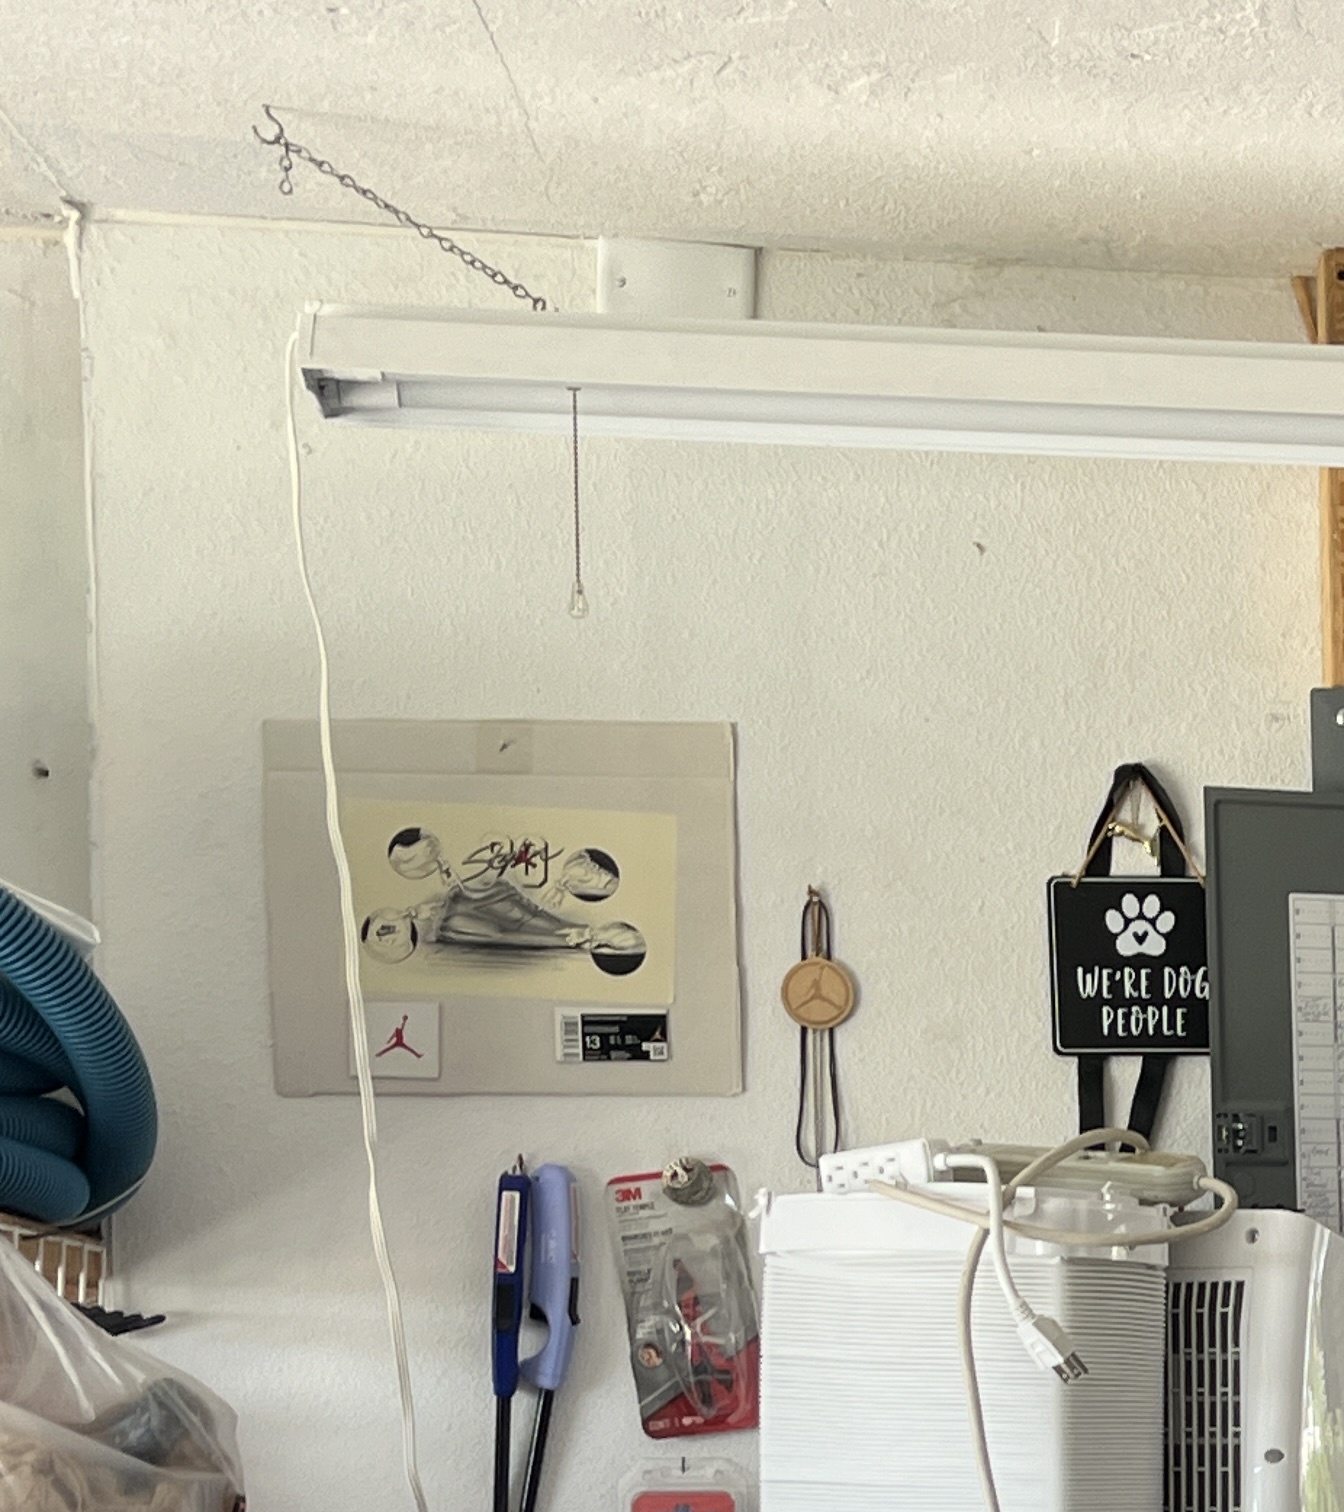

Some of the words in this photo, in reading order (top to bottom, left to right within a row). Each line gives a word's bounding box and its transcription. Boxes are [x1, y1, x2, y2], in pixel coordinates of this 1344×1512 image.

[1076, 966, 1152, 1000] WE'RE
[1163, 965, 1210, 1000] DOG
[1101, 1004, 1188, 1037] PEOPLE
[585, 1034, 601, 1050] 13
[614, 1187, 643, 1204] 3M
